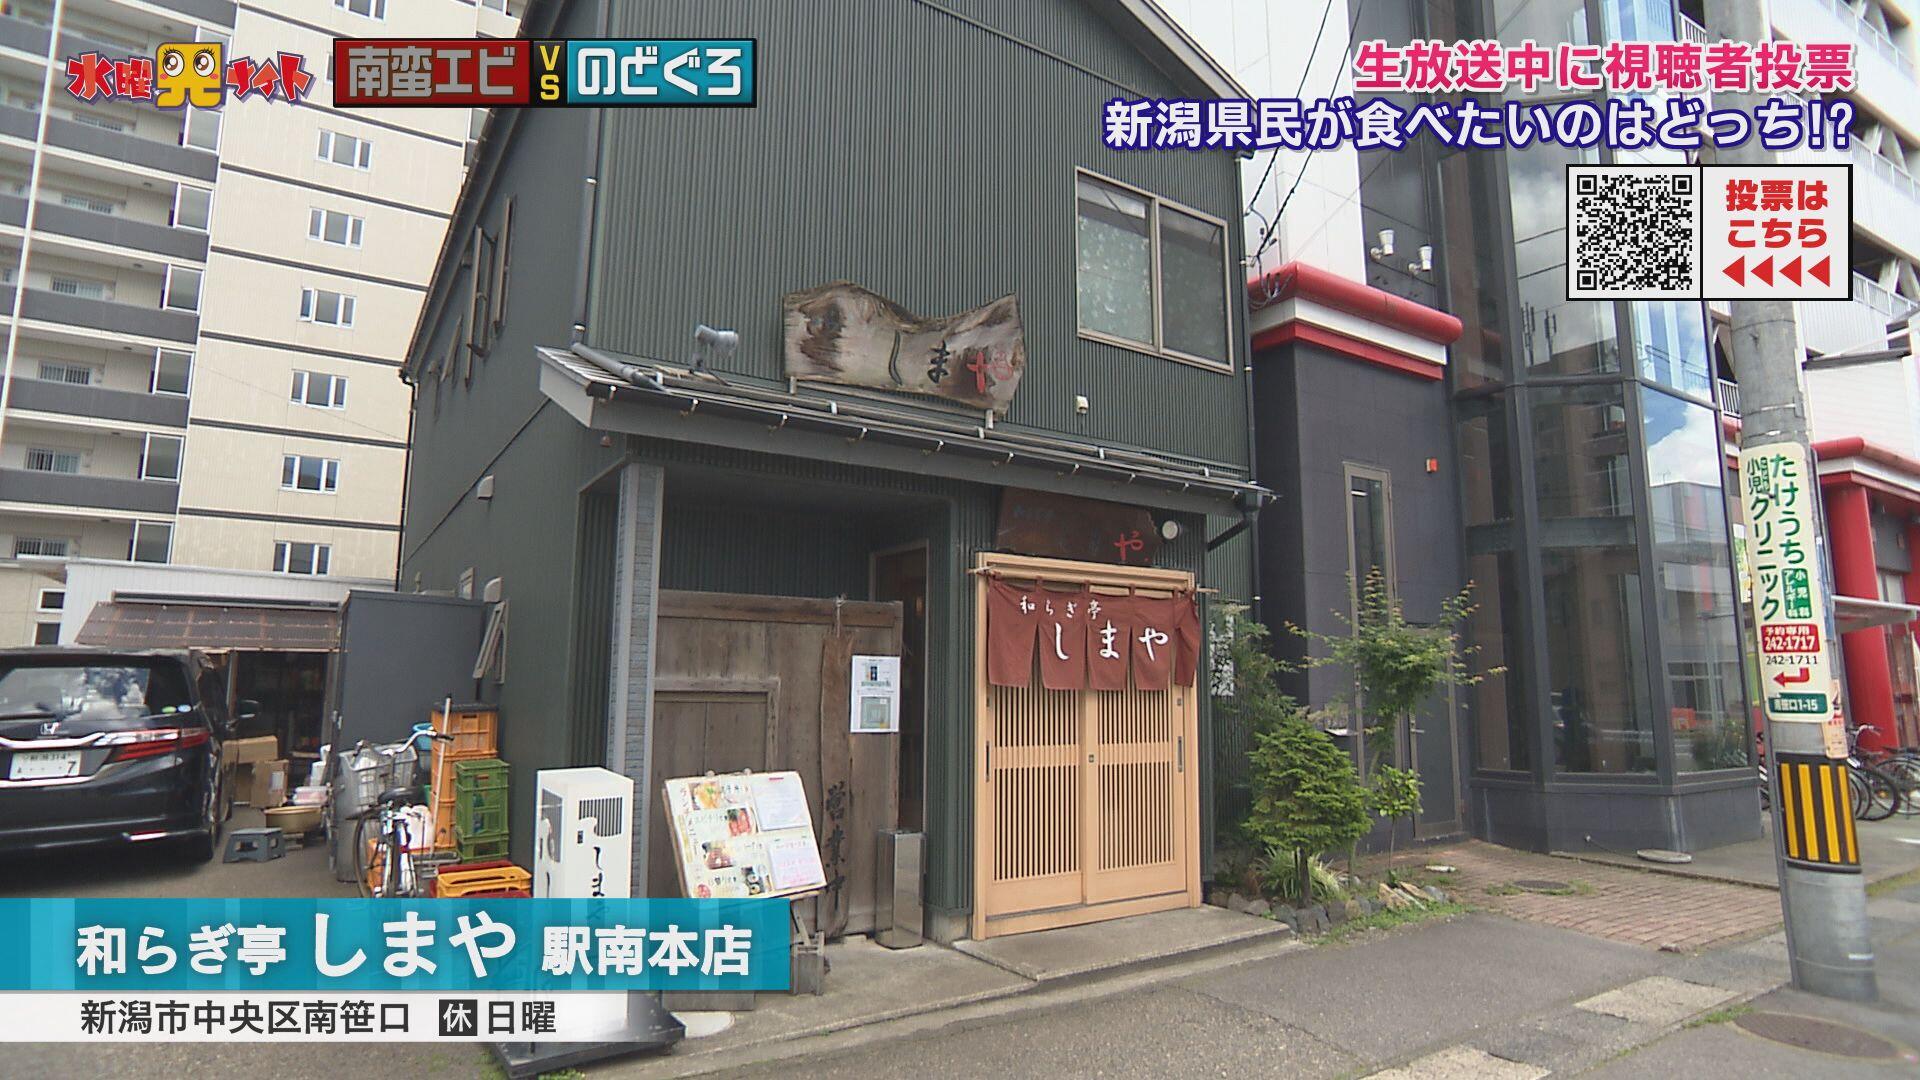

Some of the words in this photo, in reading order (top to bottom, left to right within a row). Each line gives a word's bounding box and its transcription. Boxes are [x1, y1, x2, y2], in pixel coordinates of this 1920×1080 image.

[888, 330, 1013, 393] しまや
[1770, 453, 1805, 566] たけうち
[1746, 457, 1780, 622] 小児クリニック
[1019, 595, 1102, 620] 和らぎ亭
[1054, 620, 1169, 662] しまや
[1766, 655, 1818, 665] 242-1711
